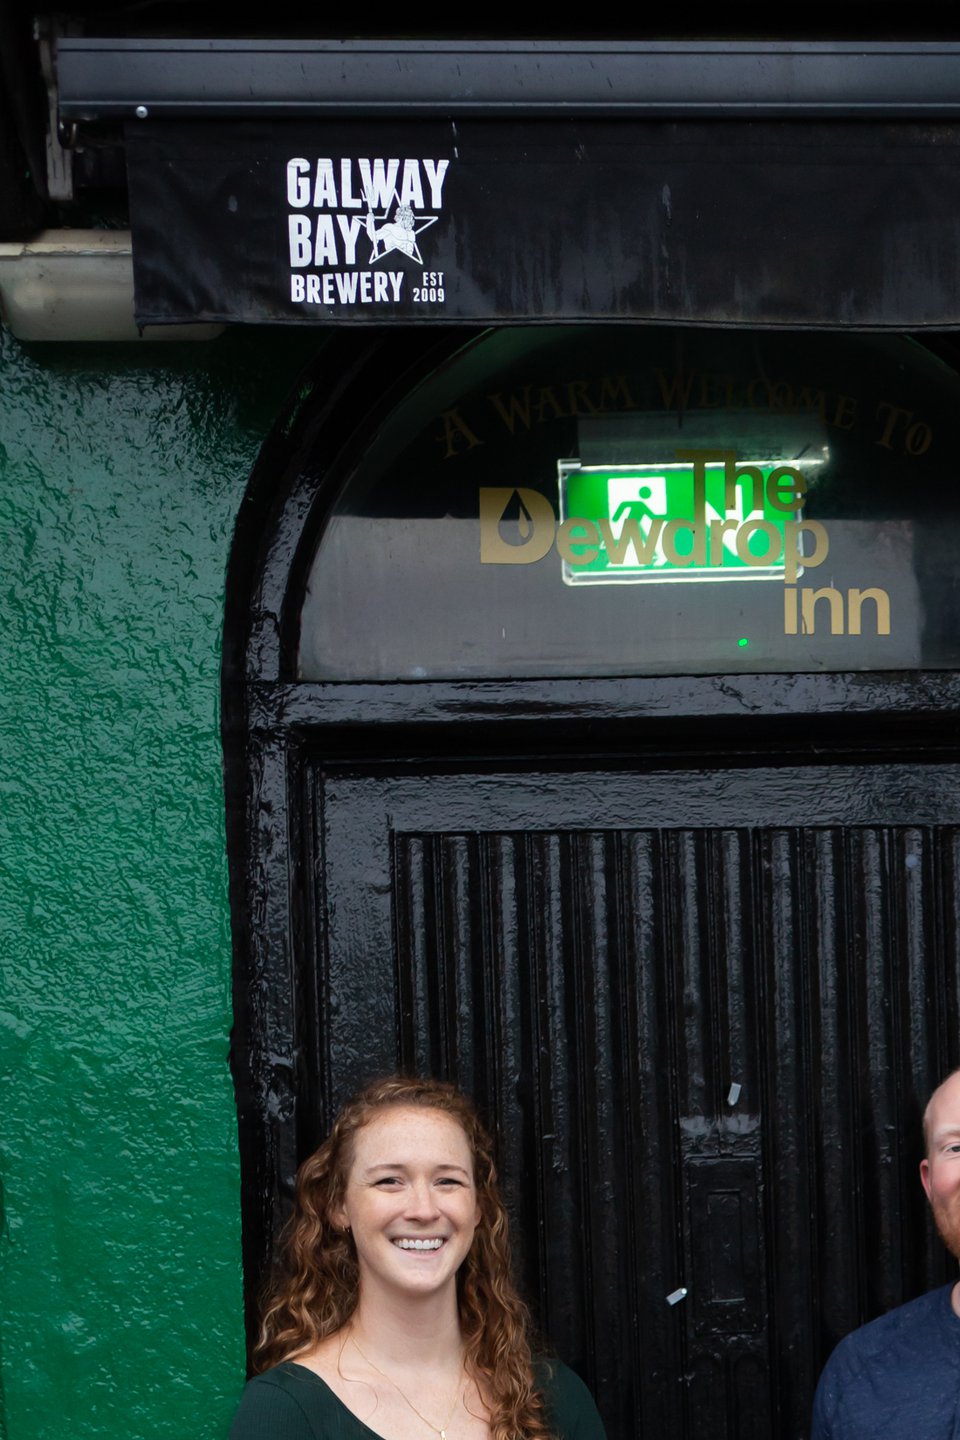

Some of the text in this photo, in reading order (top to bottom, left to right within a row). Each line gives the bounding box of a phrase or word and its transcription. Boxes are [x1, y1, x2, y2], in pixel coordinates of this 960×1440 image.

[286, 157, 450, 209] GALWAY
[288, 214, 361, 267] BAY
[290, 271, 404, 304] BREWERY
[412, 288, 445, 302] 2009
[422, 272, 444, 286] EST
[437, 407, 484, 461] A
[487, 373, 637, 435] WARM
[654, 368, 860, 431] WELCOME
[676, 449, 806, 512] The
[479, 487, 829, 583] Dewdrop
